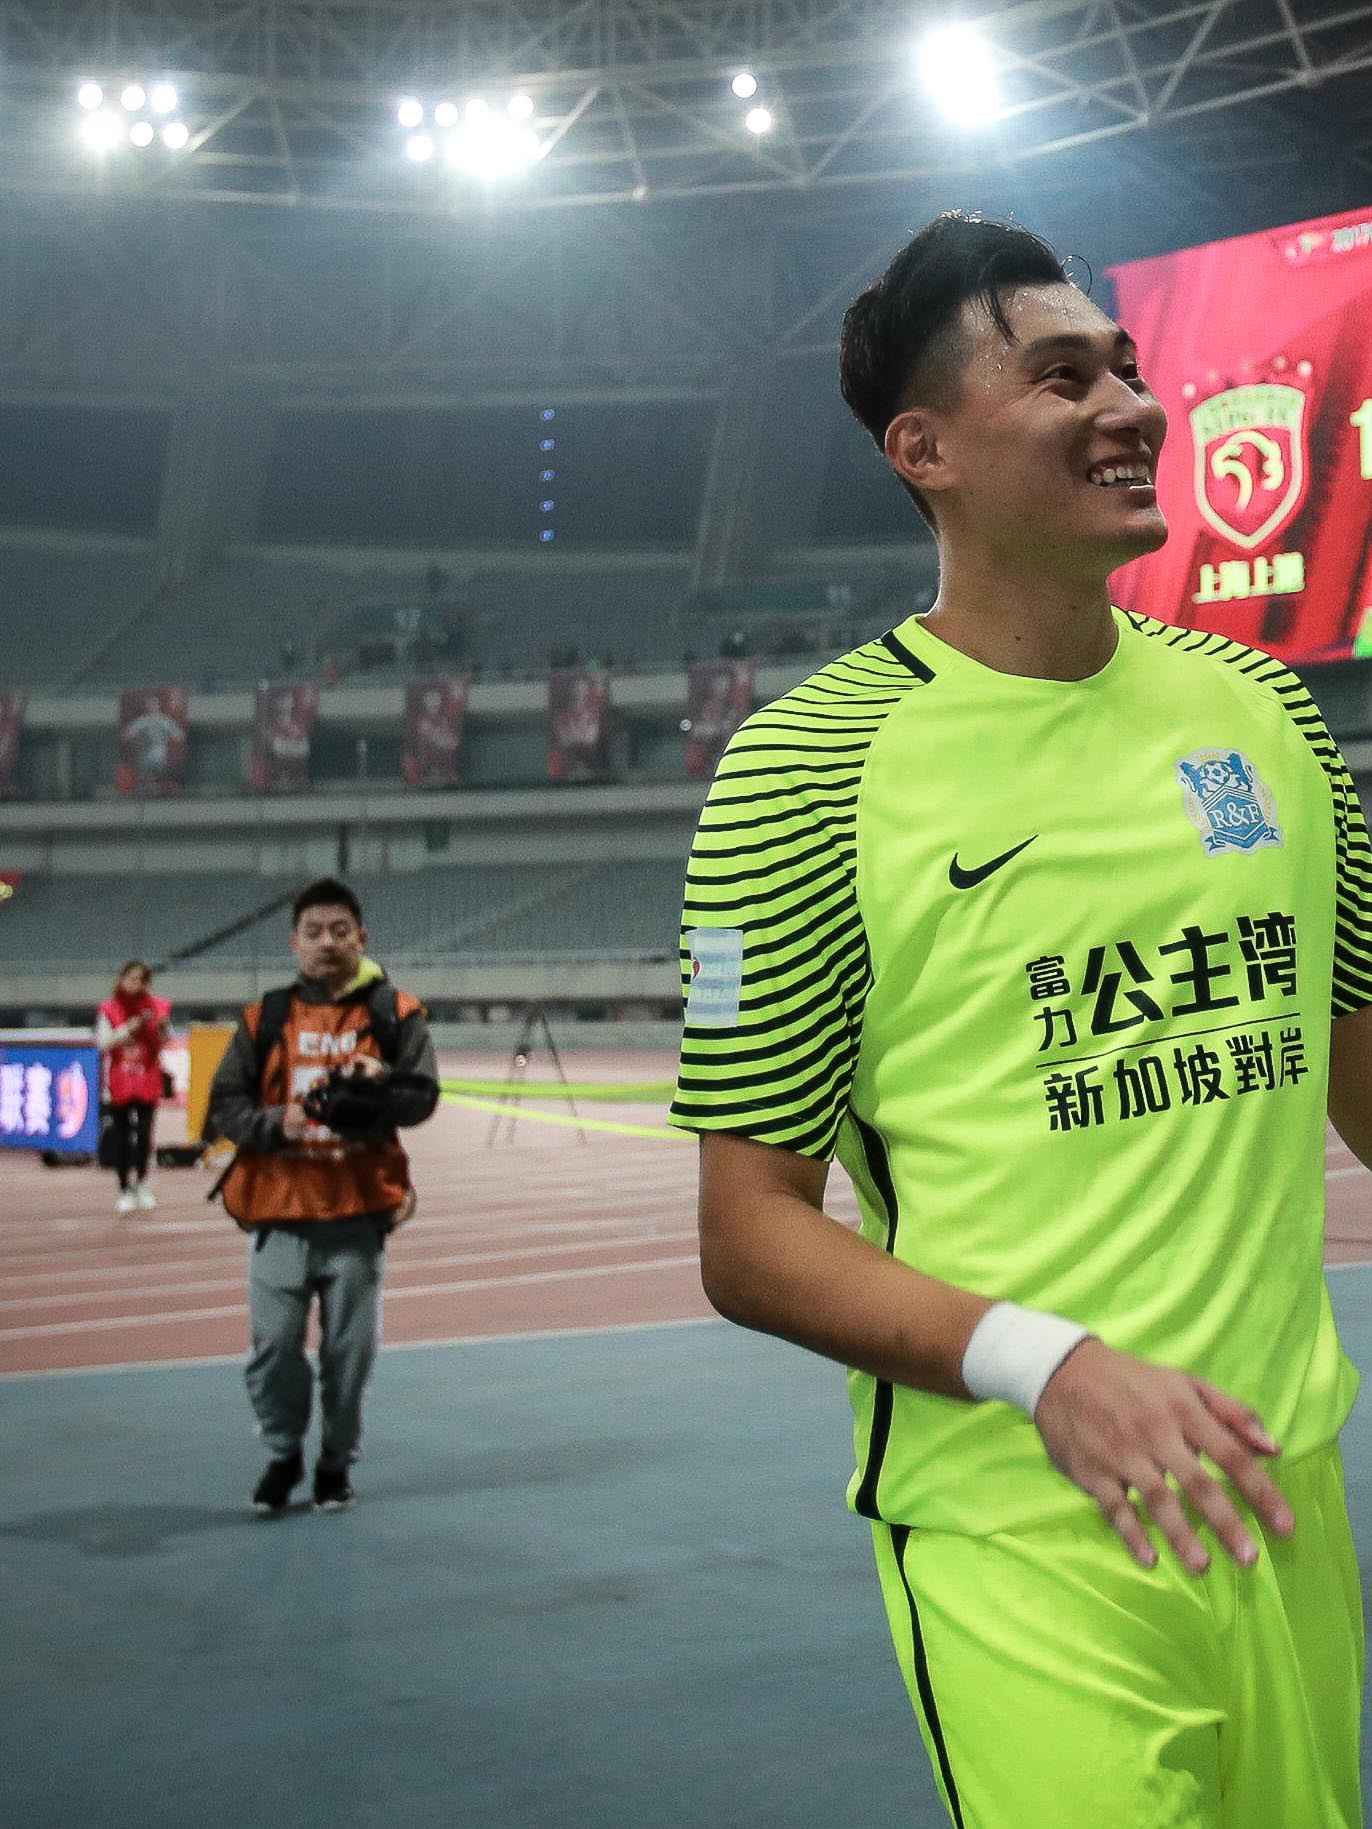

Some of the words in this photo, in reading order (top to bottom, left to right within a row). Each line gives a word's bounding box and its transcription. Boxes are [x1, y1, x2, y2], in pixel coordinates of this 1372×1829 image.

[1208, 801, 1261, 829] R&F
[1080, 911, 1298, 1037] 公主湾
[1043, 1026, 1310, 1132] 新加坡對岸
